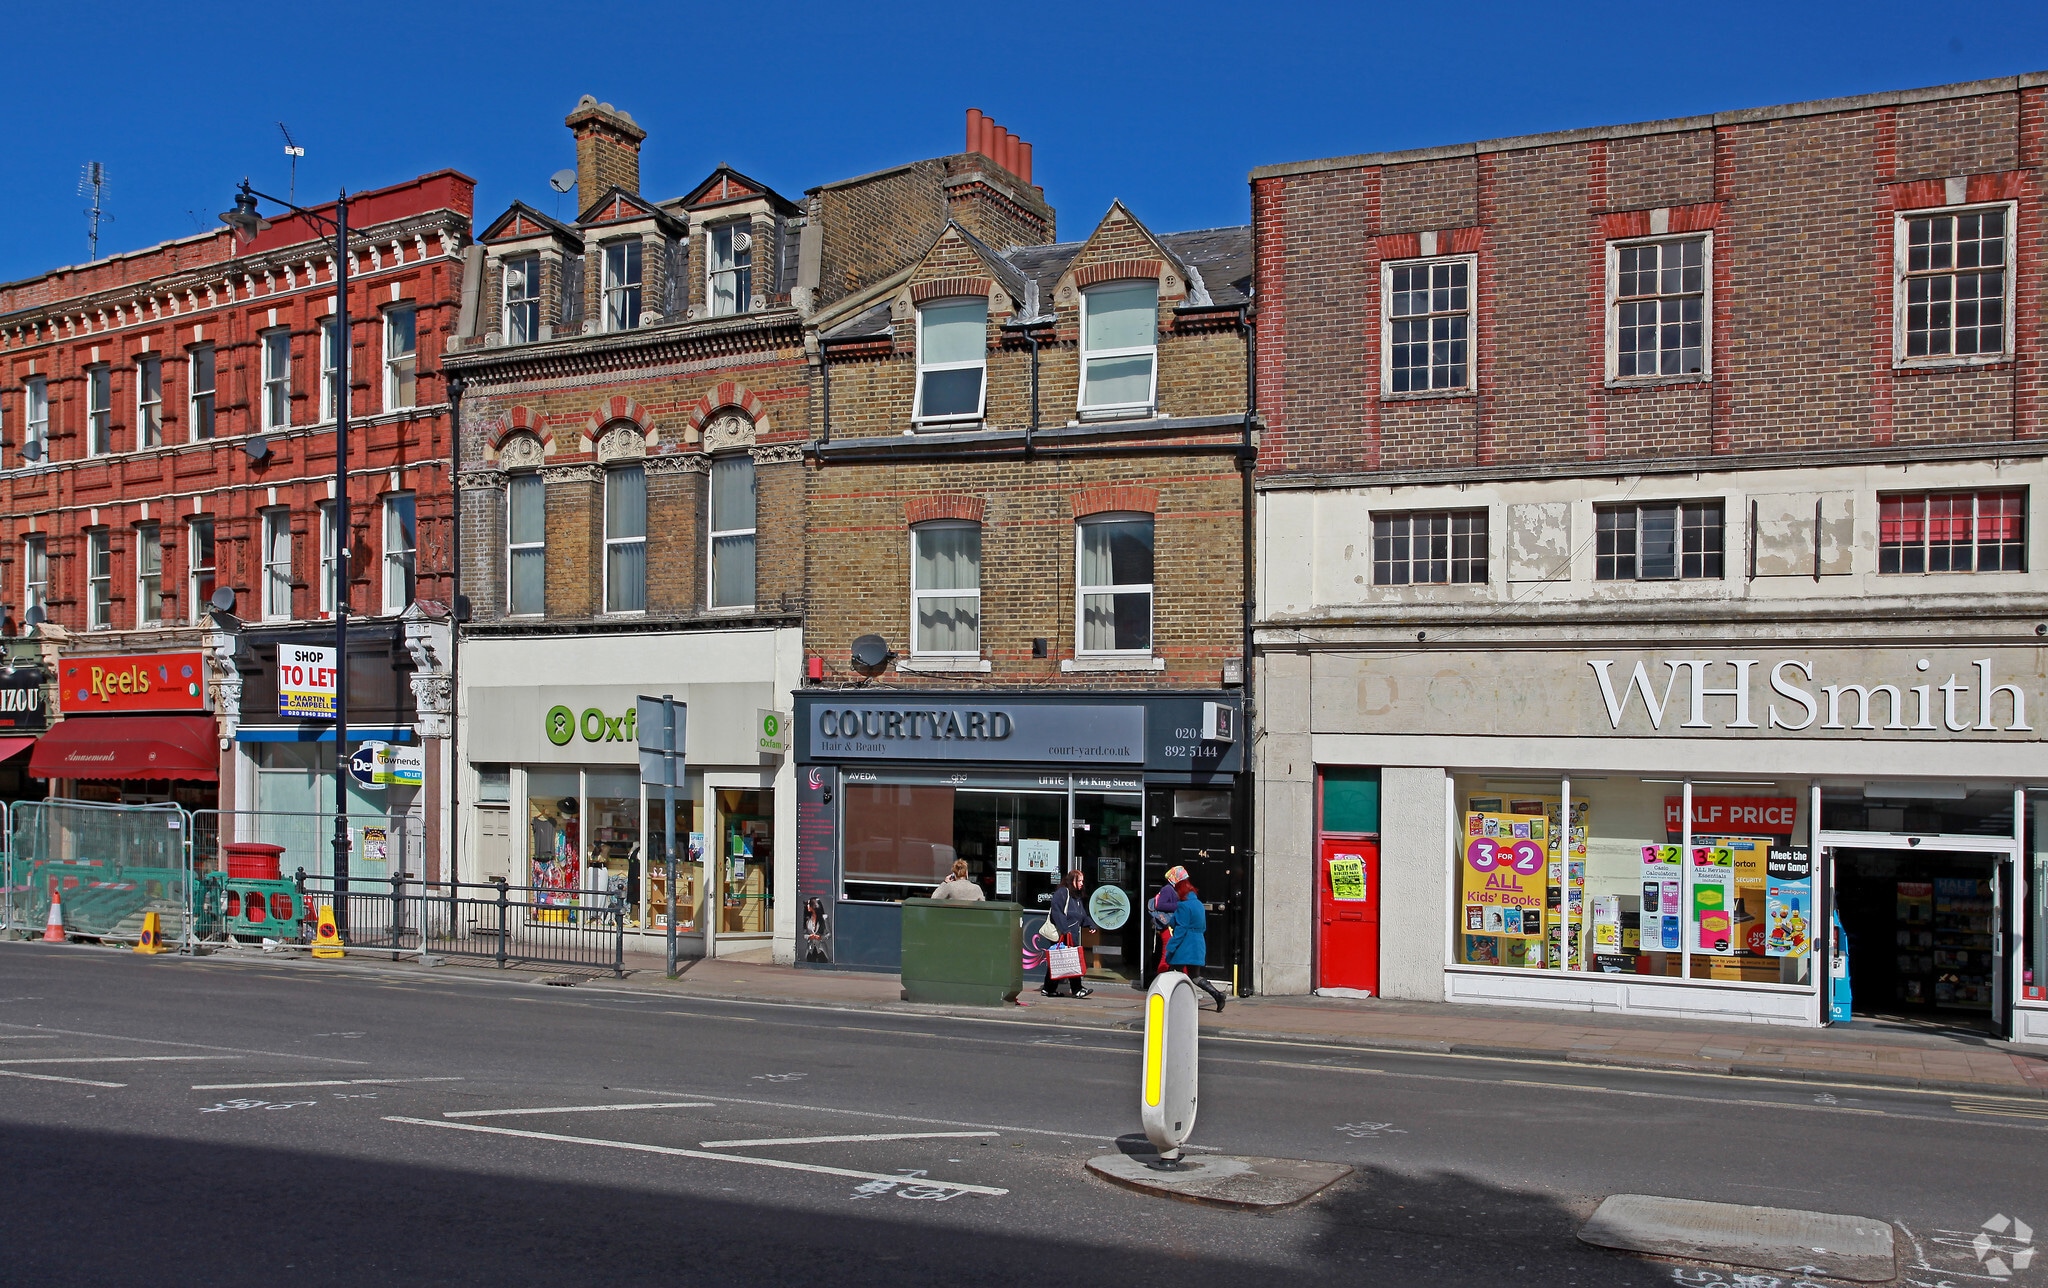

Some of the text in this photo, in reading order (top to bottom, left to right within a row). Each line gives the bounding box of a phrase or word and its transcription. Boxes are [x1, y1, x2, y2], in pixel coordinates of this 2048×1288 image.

[295, 651, 323, 662] SHOP
[282, 665, 337, 687] TO LET
[91, 665, 150, 702] Reels
[1587, 658, 2033, 731] WHSmith
[290, 700, 330, 709] CAMPBELL
[581, 707, 639, 742] Oxf
[819, 709, 1014, 740] COURTYARD
[1175, 728, 1196, 739] 020
[760, 738, 781, 749] Oxfam
[821, 741, 887, 754] Hair & Beauty
[65, 750, 115, 761] Amusements
[1048, 745, 1130, 758] court-yard.co.uk
[1165, 746, 1218, 757] 892 5144
[380, 755, 420, 766] Townends
[849, 772, 877, 781] AVEDA
[951, 772, 968, 784] ghd
[1079, 777, 1137, 788] 44 King Street
[1667, 806, 1794, 825] HALF PRICE
[1476, 844, 1493, 867] 3
[1517, 847, 1534, 869] 2
[1645, 847, 1657, 862] 3
[1667, 847, 1677, 863] 2
[1694, 849, 1707, 865] 3
[1717, 849, 1729, 865] 2
[1771, 850, 1807, 860] Meet the
[1734, 860, 1756, 868] orton
[1769, 862, 1809, 874] New Gang!
[1486, 873, 1523, 890] ALL
[1502, 893, 1541, 907] Books
